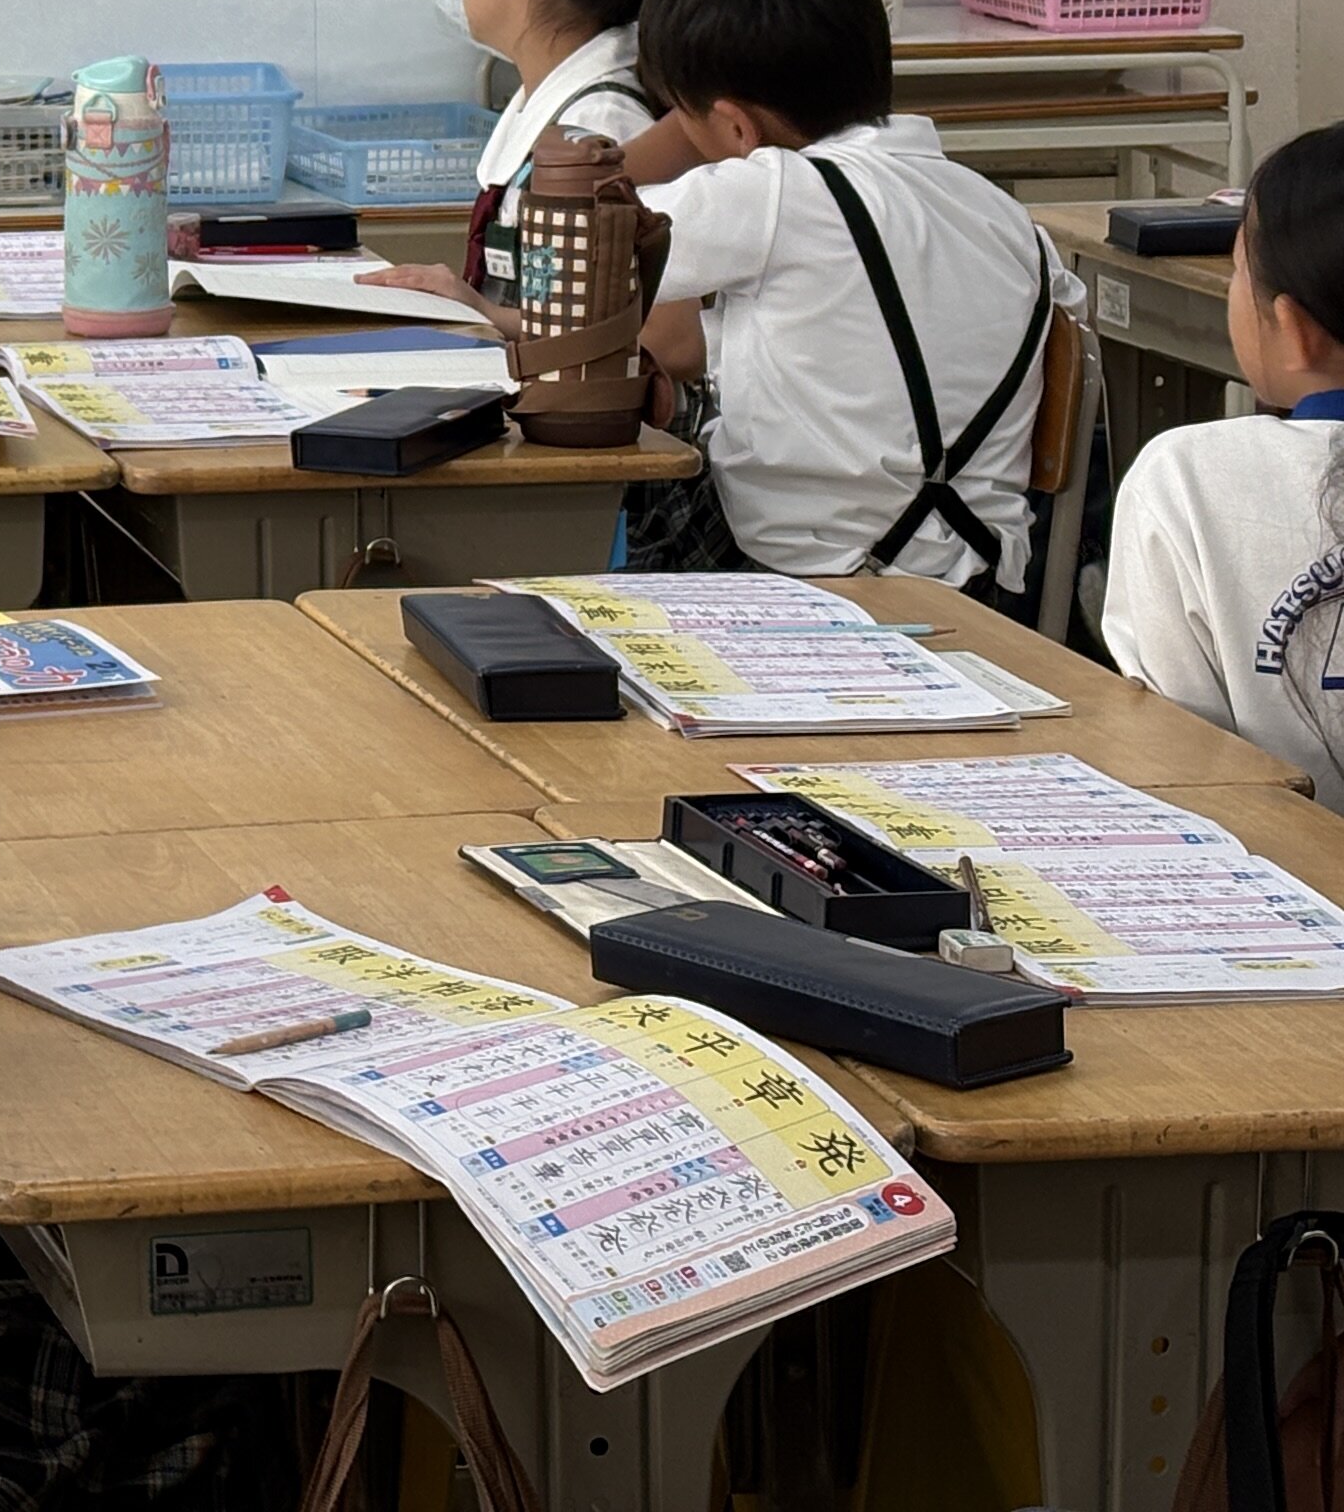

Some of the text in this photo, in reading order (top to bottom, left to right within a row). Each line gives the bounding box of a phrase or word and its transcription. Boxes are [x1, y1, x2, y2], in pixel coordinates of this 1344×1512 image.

[1255, 546, 1344, 676] HATSU
[683, 1030, 742, 1059] 平
[741, 1068, 805, 1111] 章
[796, 1128, 868, 1178] 発
[727, 1168, 769, 1201] 発
[891, 1194, 914, 1209] 4
